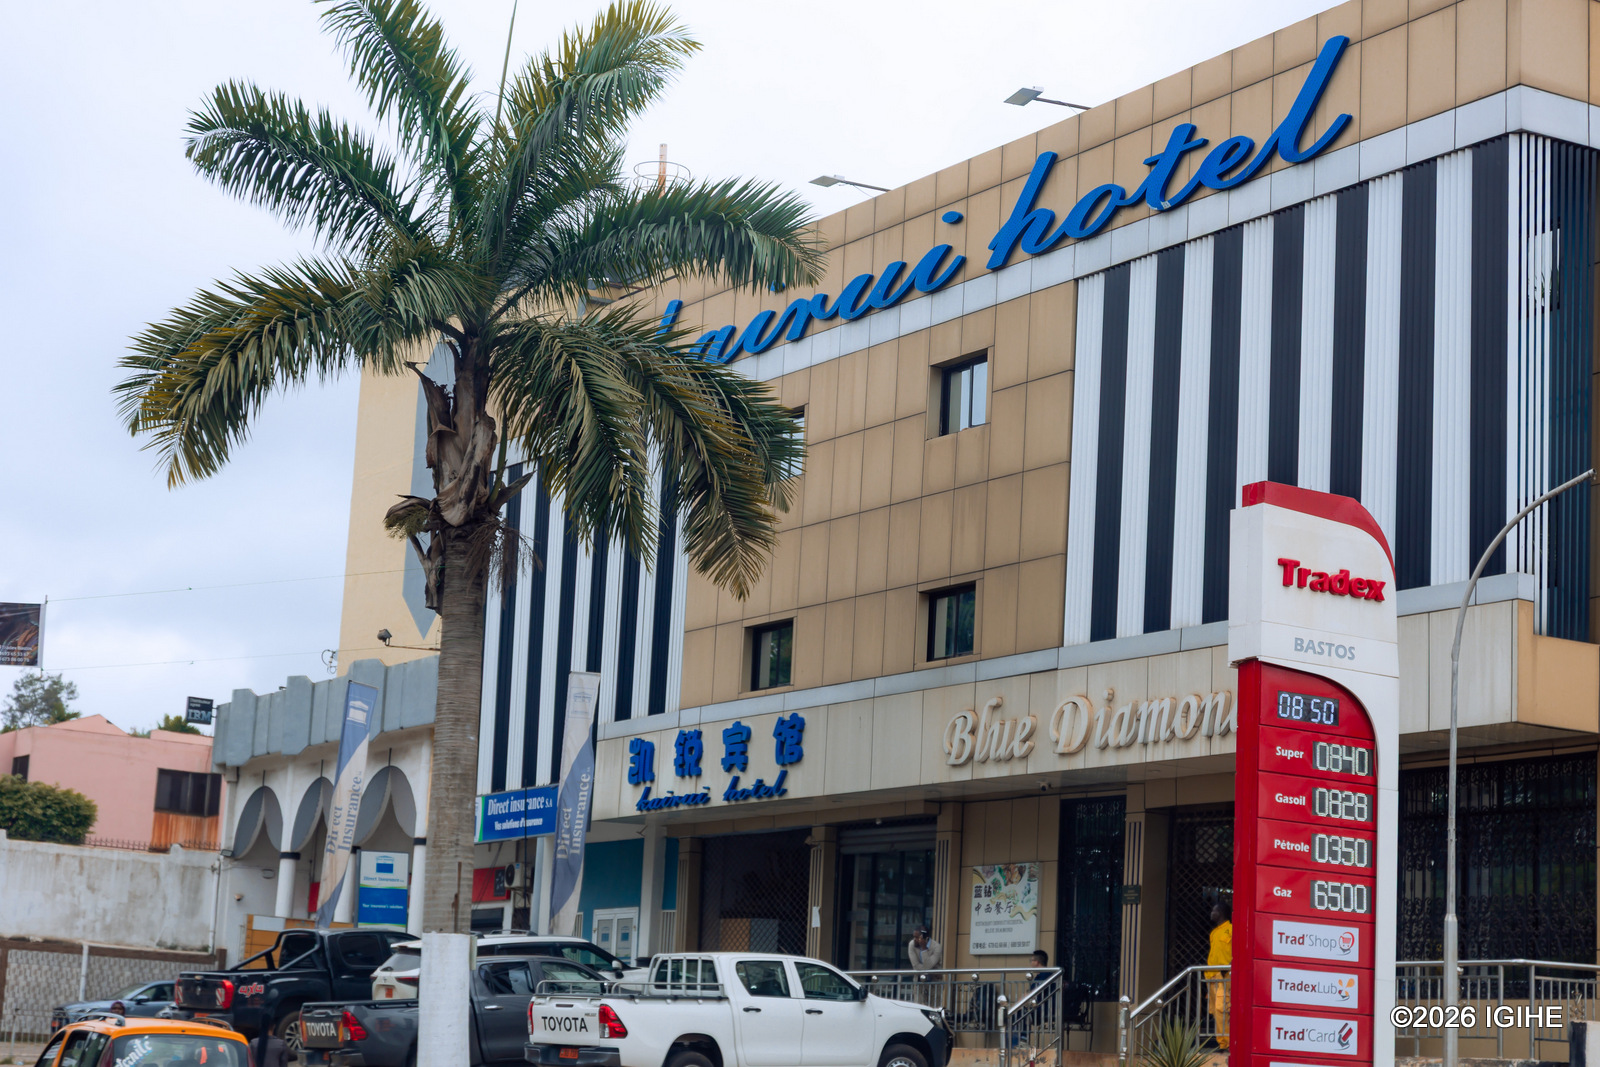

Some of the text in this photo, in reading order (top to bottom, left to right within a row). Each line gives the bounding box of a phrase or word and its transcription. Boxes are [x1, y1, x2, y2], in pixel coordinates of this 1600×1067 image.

[987, 35, 1352, 270] hotel
[1278, 558, 1386, 602] Tradex
[1294, 637, 1355, 660] BASTOS
[187, 709, 212, 722] IBM
[943, 688, 1238, 766] Blue Diamon
[627, 712, 805, 785] 凯锐宾馆
[1275, 742, 1368, 776] Super 0840
[487, 798, 509, 816] Direct
[636, 769, 788, 811] kairui hotel
[1275, 788, 1368, 822] Gasoil 0828
[325, 806, 343, 854] Direct
[337, 776, 362, 852] Insurance
[569, 773, 591, 855] Insurance
[556, 807, 572, 859] Direct
[1274, 833, 1368, 867] Pétrole 0350
[1273, 880, 1367, 914] Gaz 6500
[1277, 979, 1337, 995] TradexLub
[306, 1022, 337, 1037] TOYOTA
[541, 1016, 588, 1032] TOYOTA
